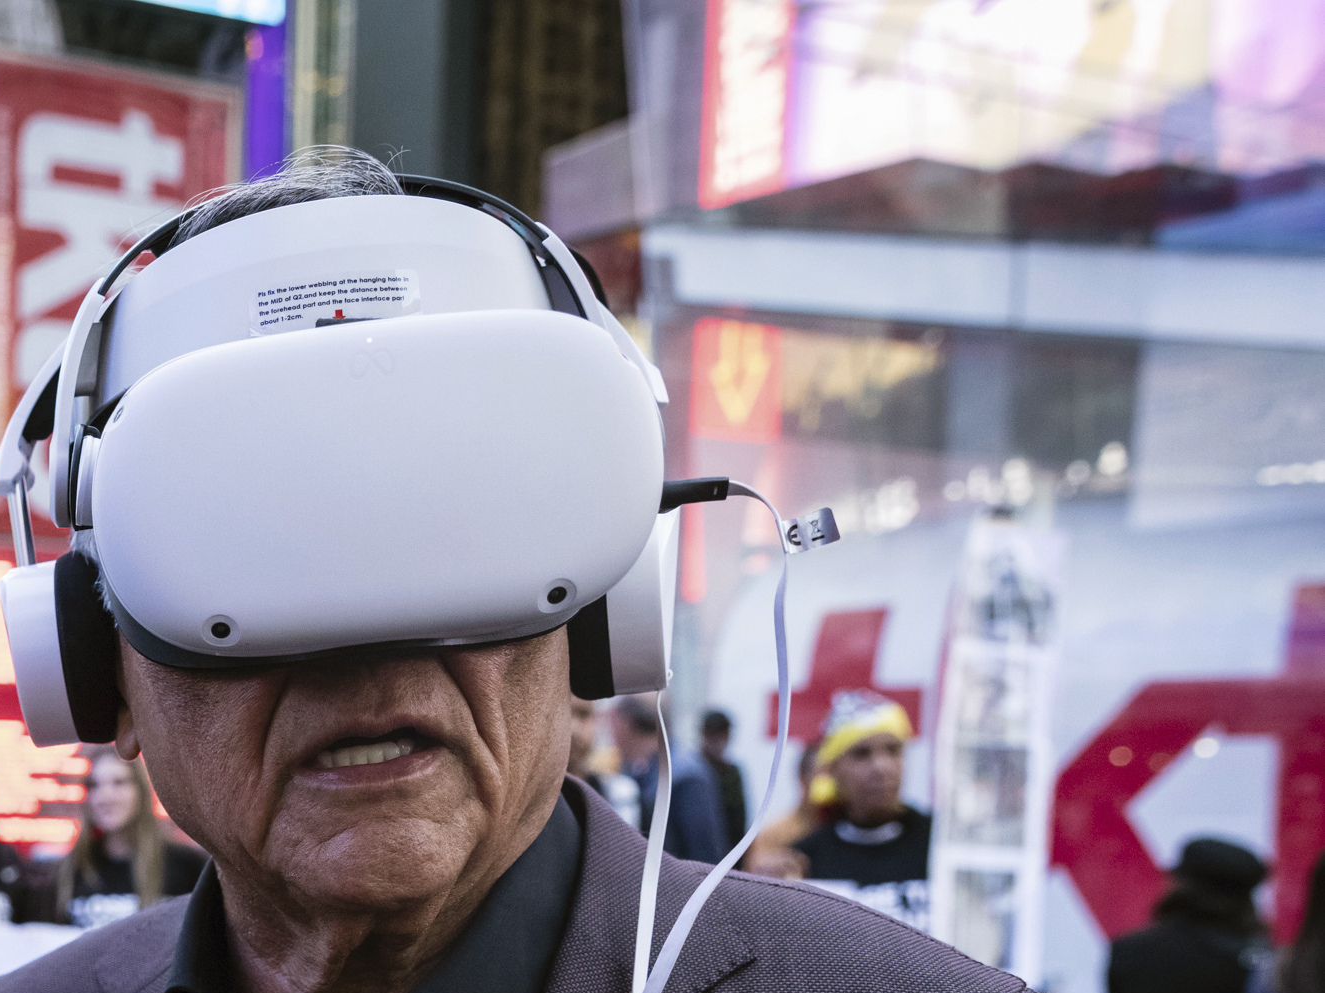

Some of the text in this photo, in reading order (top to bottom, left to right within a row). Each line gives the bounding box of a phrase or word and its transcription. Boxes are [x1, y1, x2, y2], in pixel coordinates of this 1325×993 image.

[288, 284, 307, 292] lower
[350, 286, 378, 294] distance
[271, 304, 301, 314] forehead
[260, 314, 303, 326] about 1-2cm.
